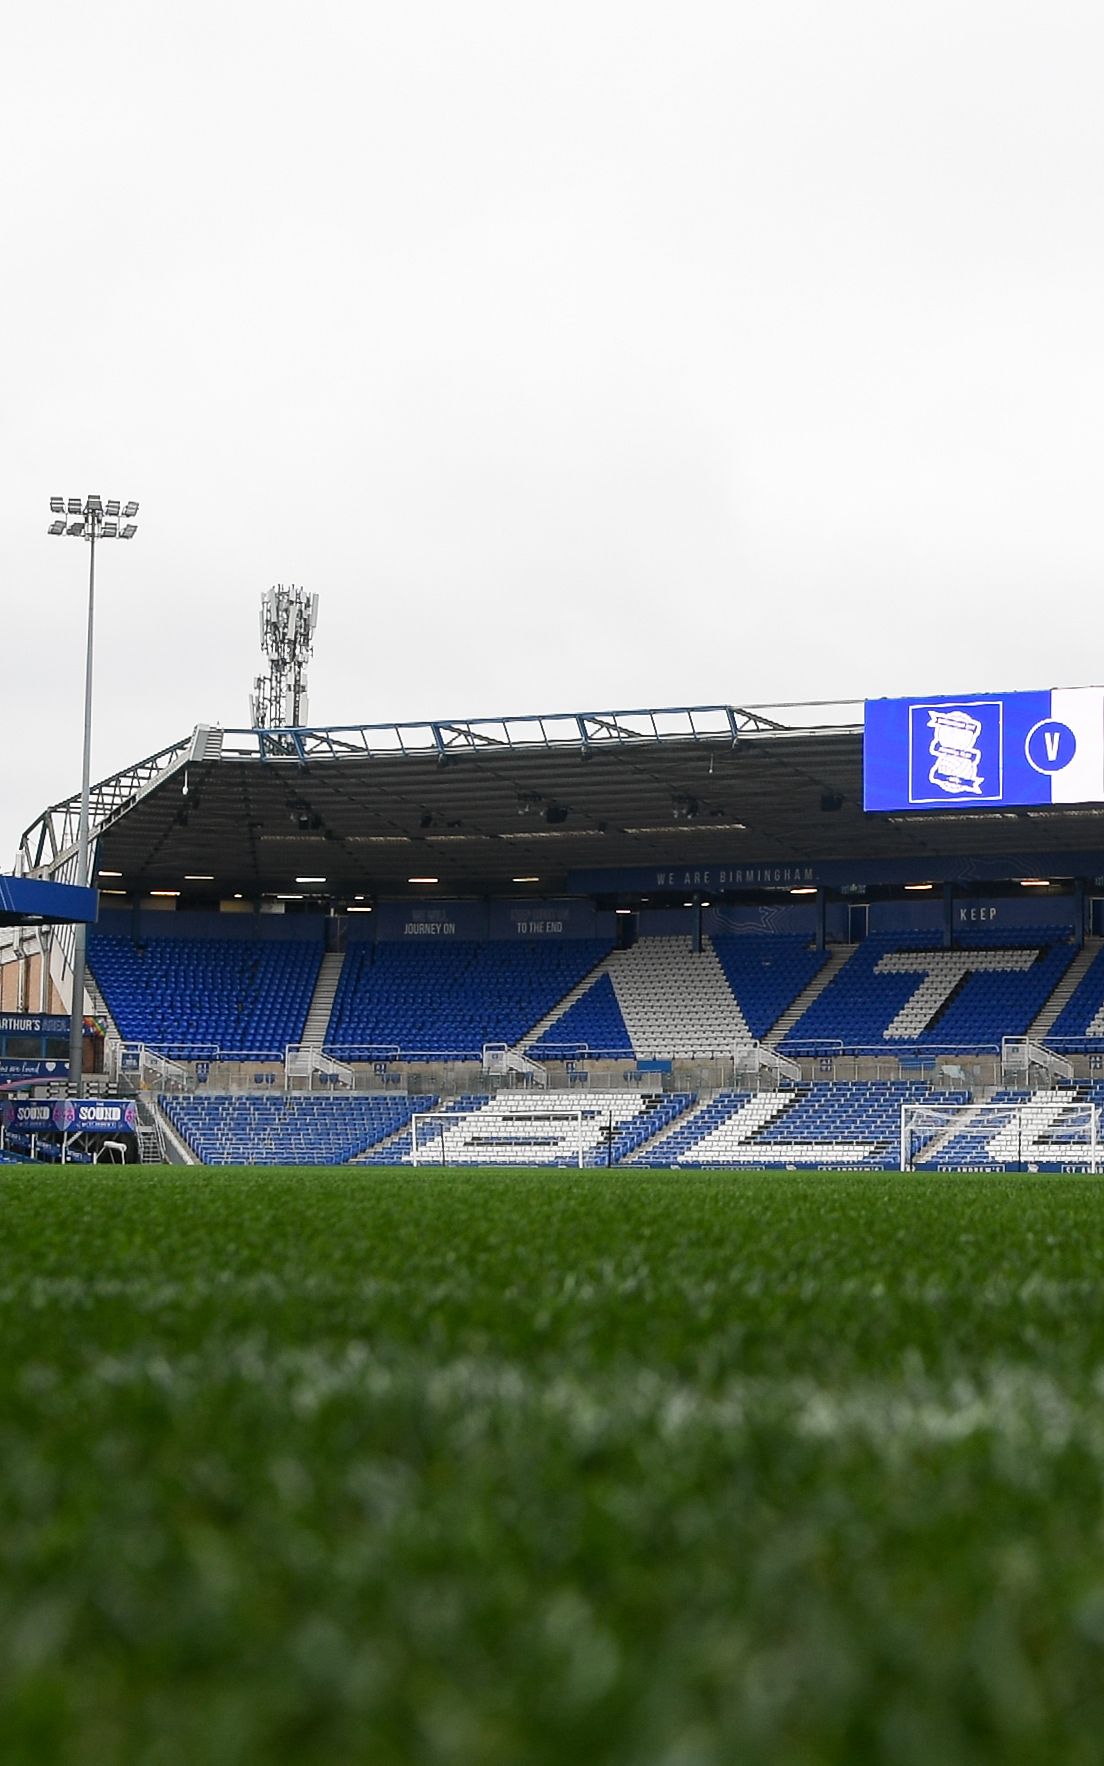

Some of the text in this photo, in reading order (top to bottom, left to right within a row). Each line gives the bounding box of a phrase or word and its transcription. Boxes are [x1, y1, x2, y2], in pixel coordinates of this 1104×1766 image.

[1044, 732, 1060, 761] V
[656, 872, 674, 885] WE
[684, 871, 710, 885] ARE
[960, 907, 997, 921] KEEP
[403, 922, 456, 935] JOURNEY ON
[517, 921, 563, 934] TO THE END
[0, 1018, 41, 1031] RTHUR'S
[17, 1106, 50, 1121] SOUND
[79, 1106, 121, 1121] SOUND
